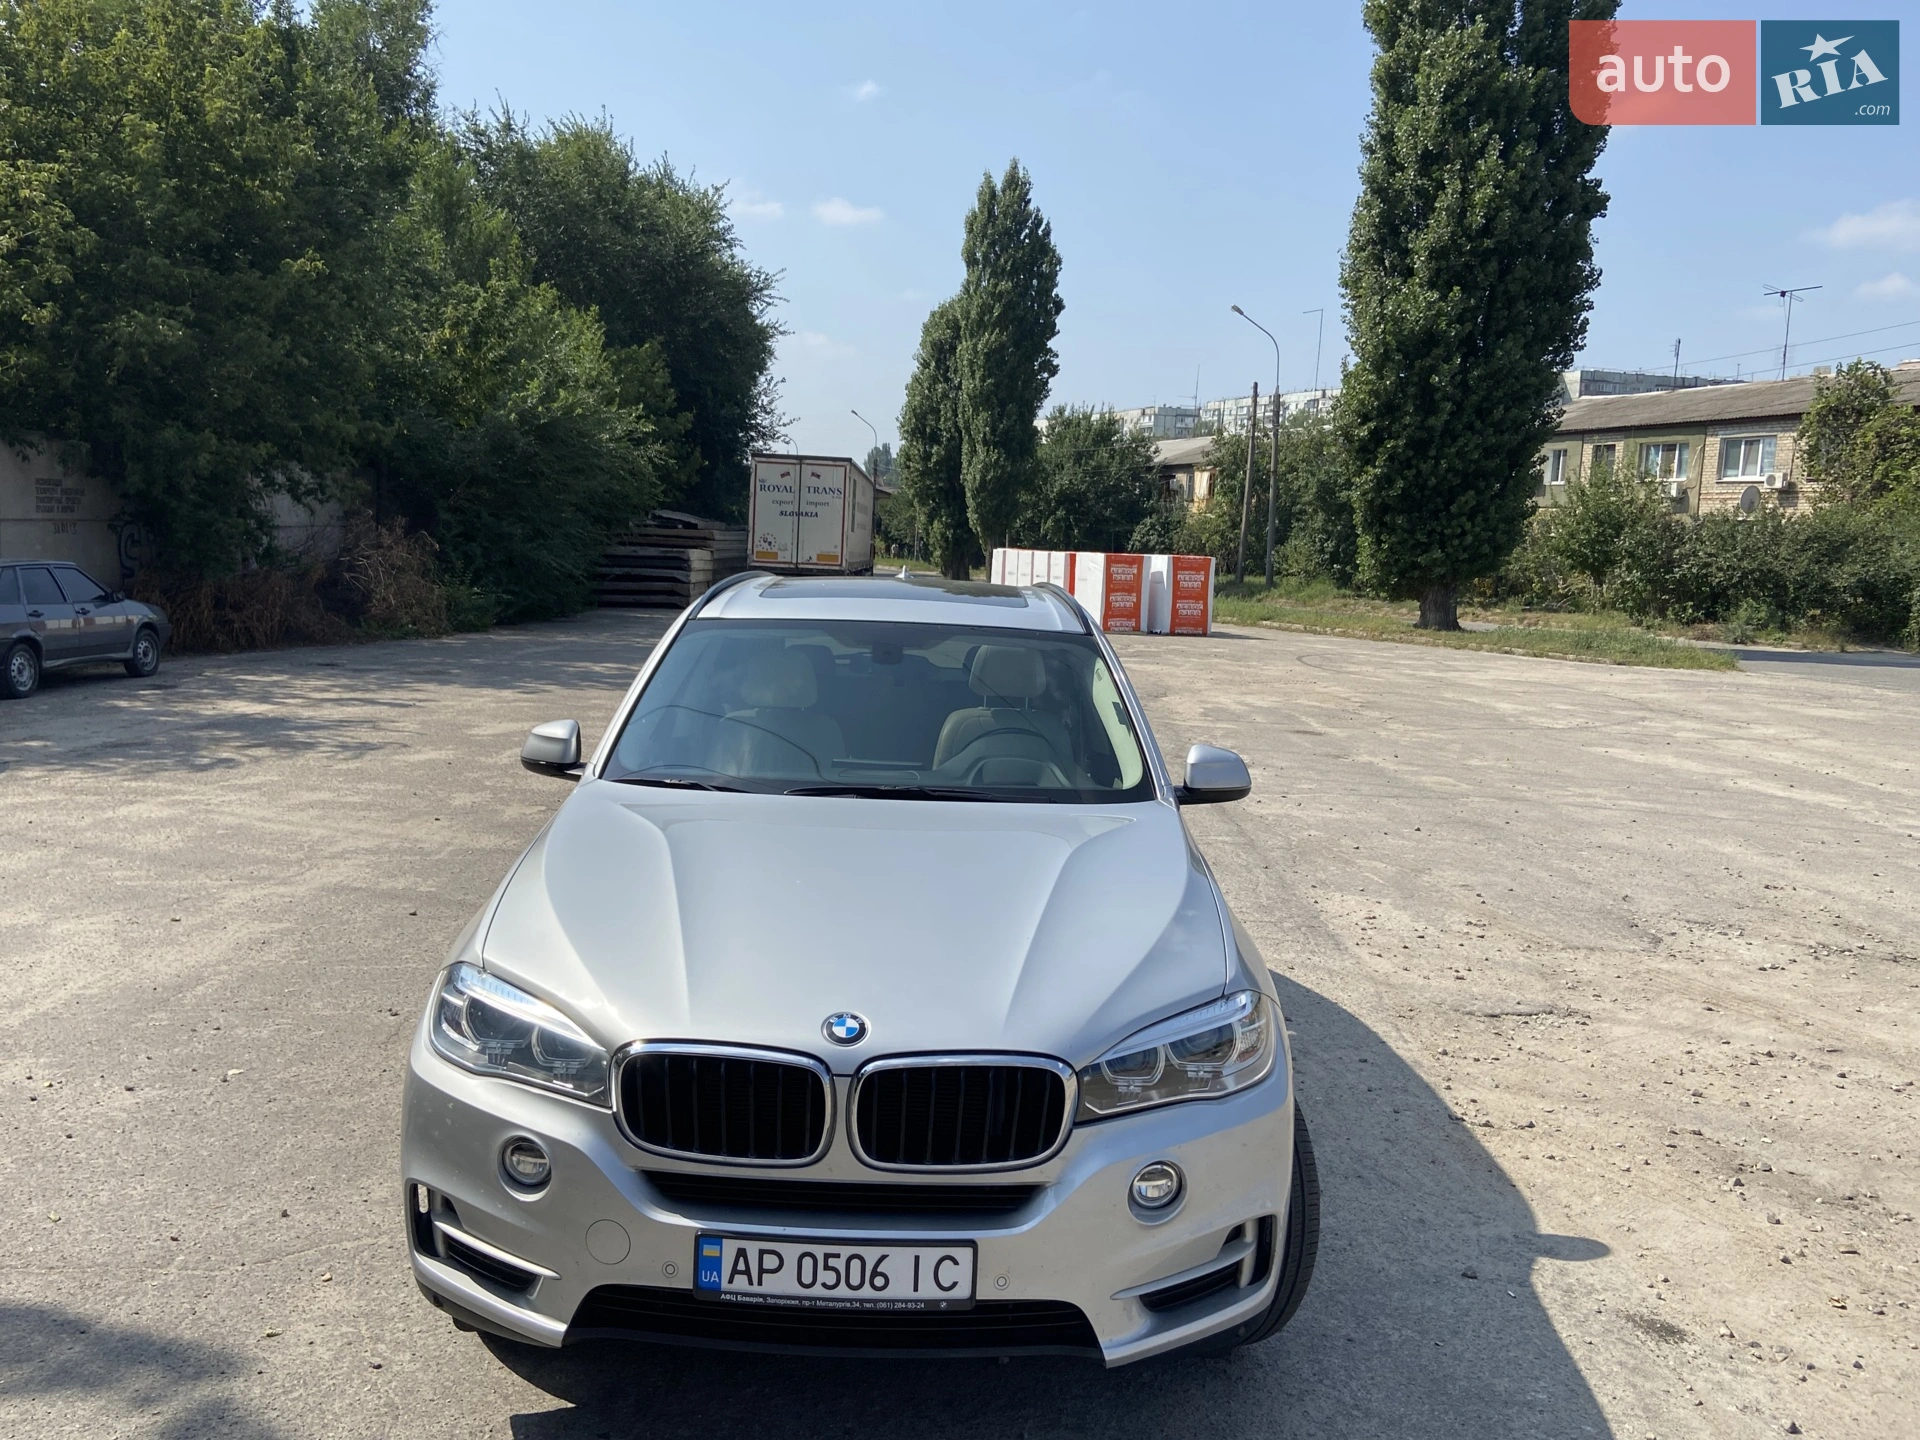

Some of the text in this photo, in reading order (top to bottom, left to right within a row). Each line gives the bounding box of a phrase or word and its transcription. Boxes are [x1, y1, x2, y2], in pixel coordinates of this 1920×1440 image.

[759, 483, 842, 496] ROYAL TRANS
[806, 500, 829, 508] import
[727, 1247, 785, 1287] AP
[796, 1250, 890, 1292] 0506
[701, 1270, 720, 1283] UA
[720, 1293, 736, 1301] АФЦ
[876, 1301, 893, 1309] (061)
